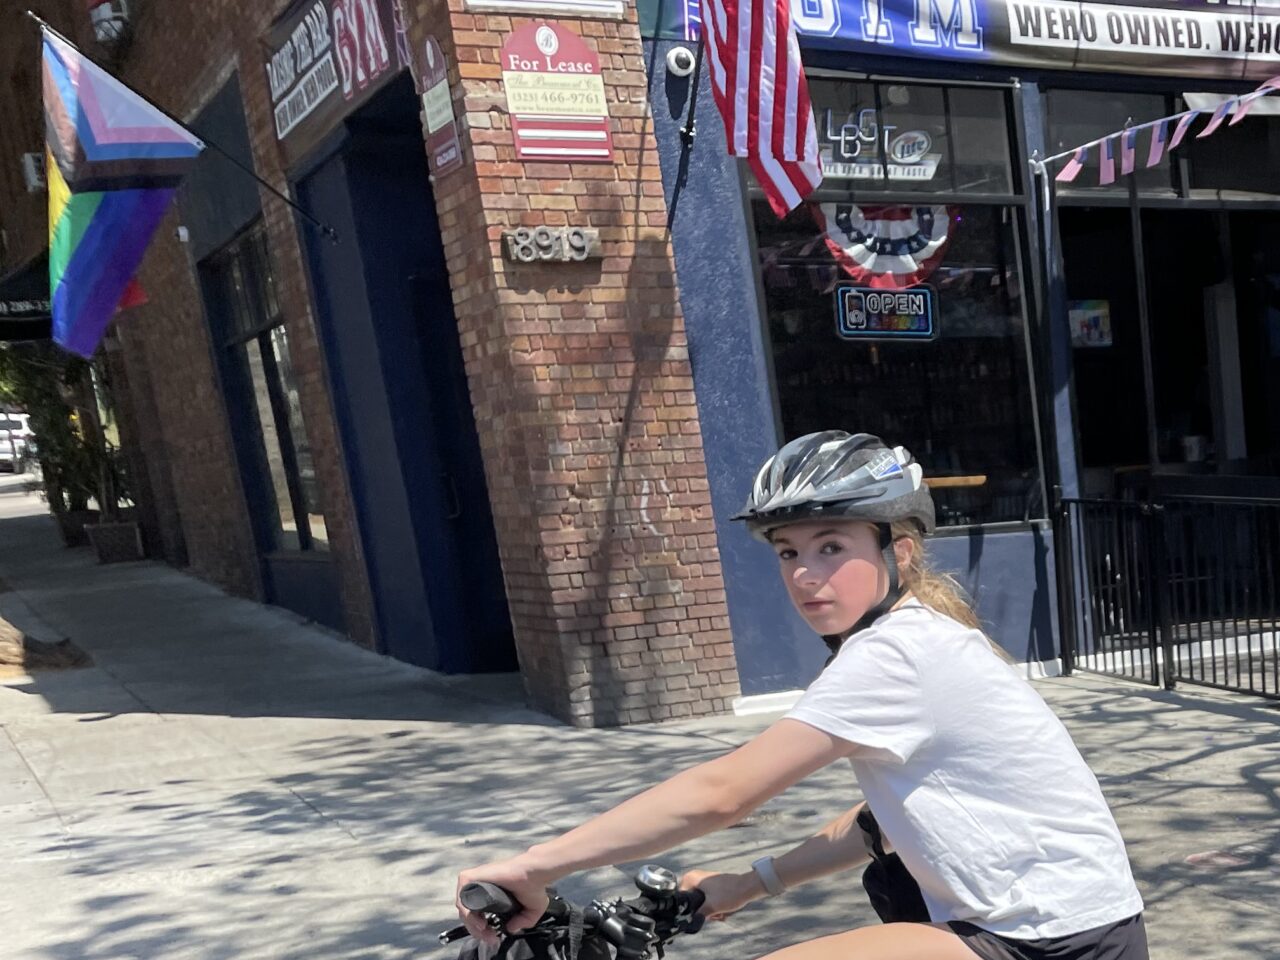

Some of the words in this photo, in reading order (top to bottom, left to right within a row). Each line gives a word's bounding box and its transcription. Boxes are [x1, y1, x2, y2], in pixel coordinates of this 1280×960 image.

[1012, 3, 1098, 42] WEHO
[1107, 11, 1211, 51] OWNED.
[508, 54, 539, 70] For
[545, 56, 593, 73] Lease
[540, 91, 600, 105] 466-9761
[514, 226, 588, 262] 8919
[866, 293, 925, 315] OPEN
